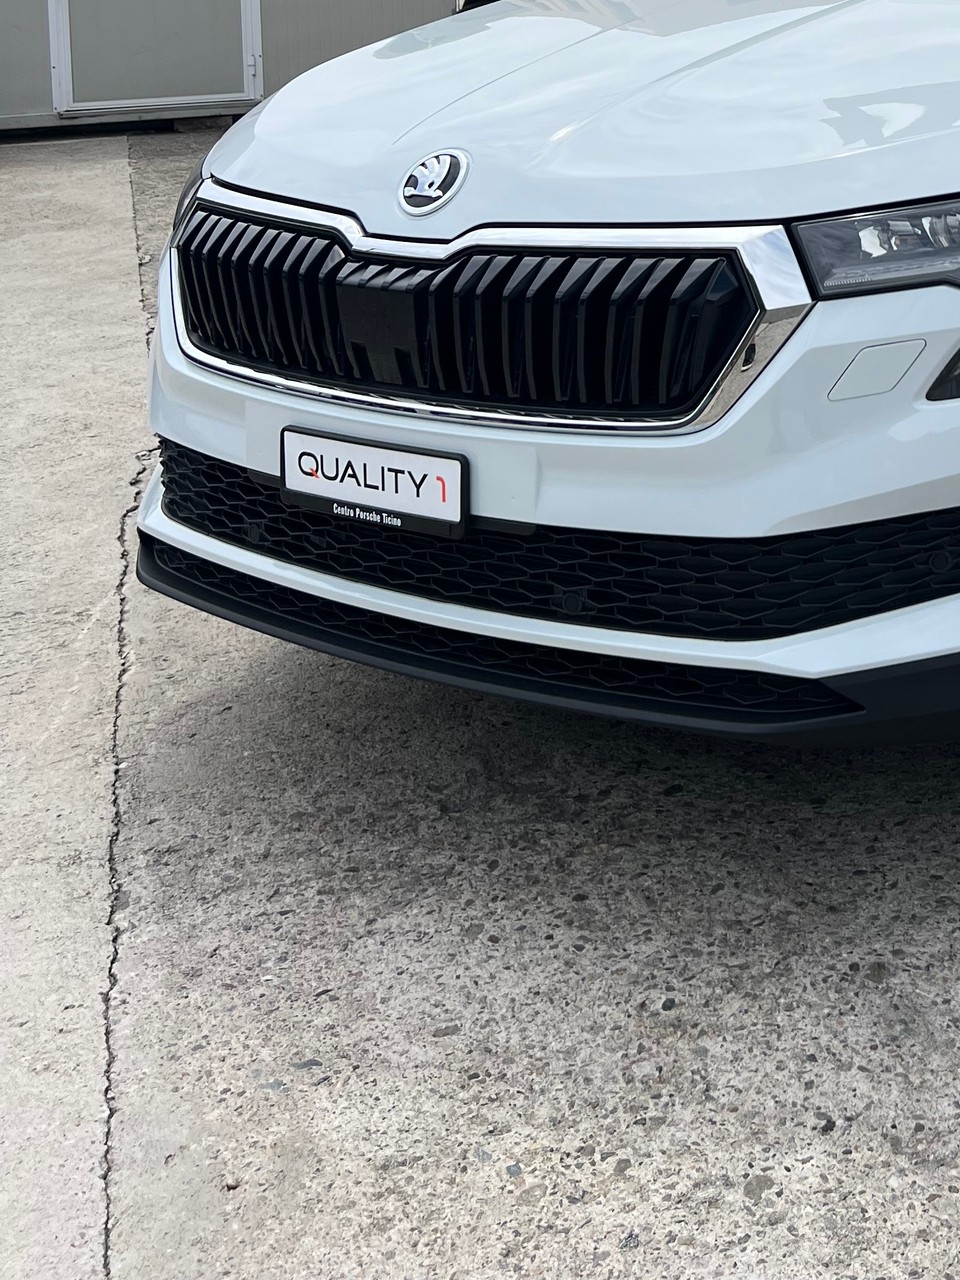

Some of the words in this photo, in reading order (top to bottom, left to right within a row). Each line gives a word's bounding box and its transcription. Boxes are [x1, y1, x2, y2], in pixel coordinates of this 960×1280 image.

[298, 451, 429, 498] QUALITY
[333, 502, 355, 517] Centro
[355, 507, 381, 523] Porsche
[382, 512, 402, 527] Ticino
